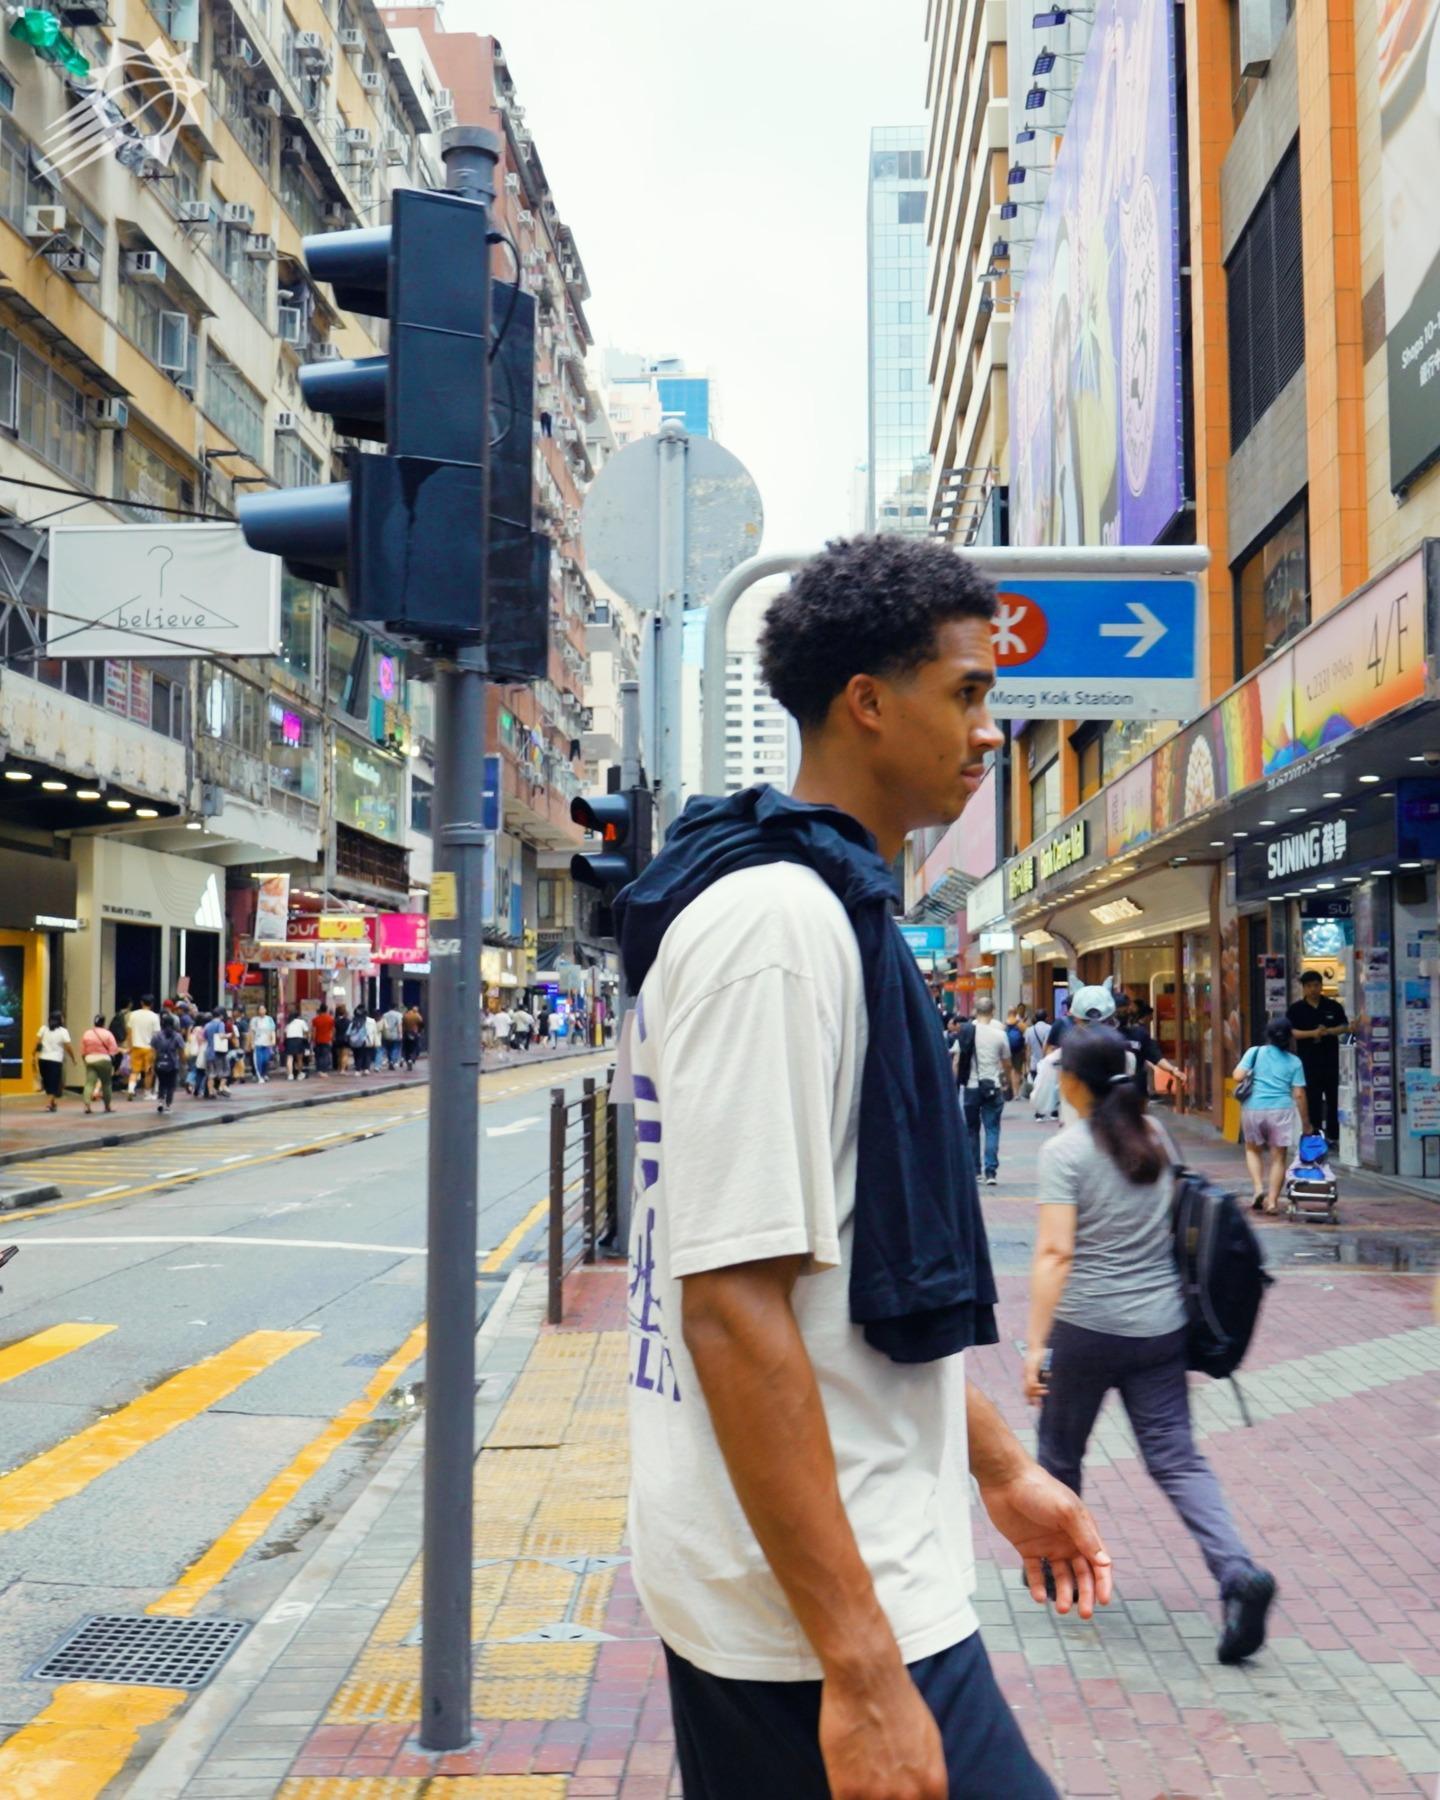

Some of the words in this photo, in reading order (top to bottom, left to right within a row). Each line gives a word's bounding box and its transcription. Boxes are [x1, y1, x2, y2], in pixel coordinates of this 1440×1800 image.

[1424, 311, 1440, 344] 10-
[118, 606, 206, 629] believe
[1367, 591, 1409, 689] 4/F
[989, 690, 1036, 709] Mong
[1040, 690, 1070, 705] Kok
[1074, 690, 1134, 706] Station
[1267, 827, 1321, 880] SUNING
